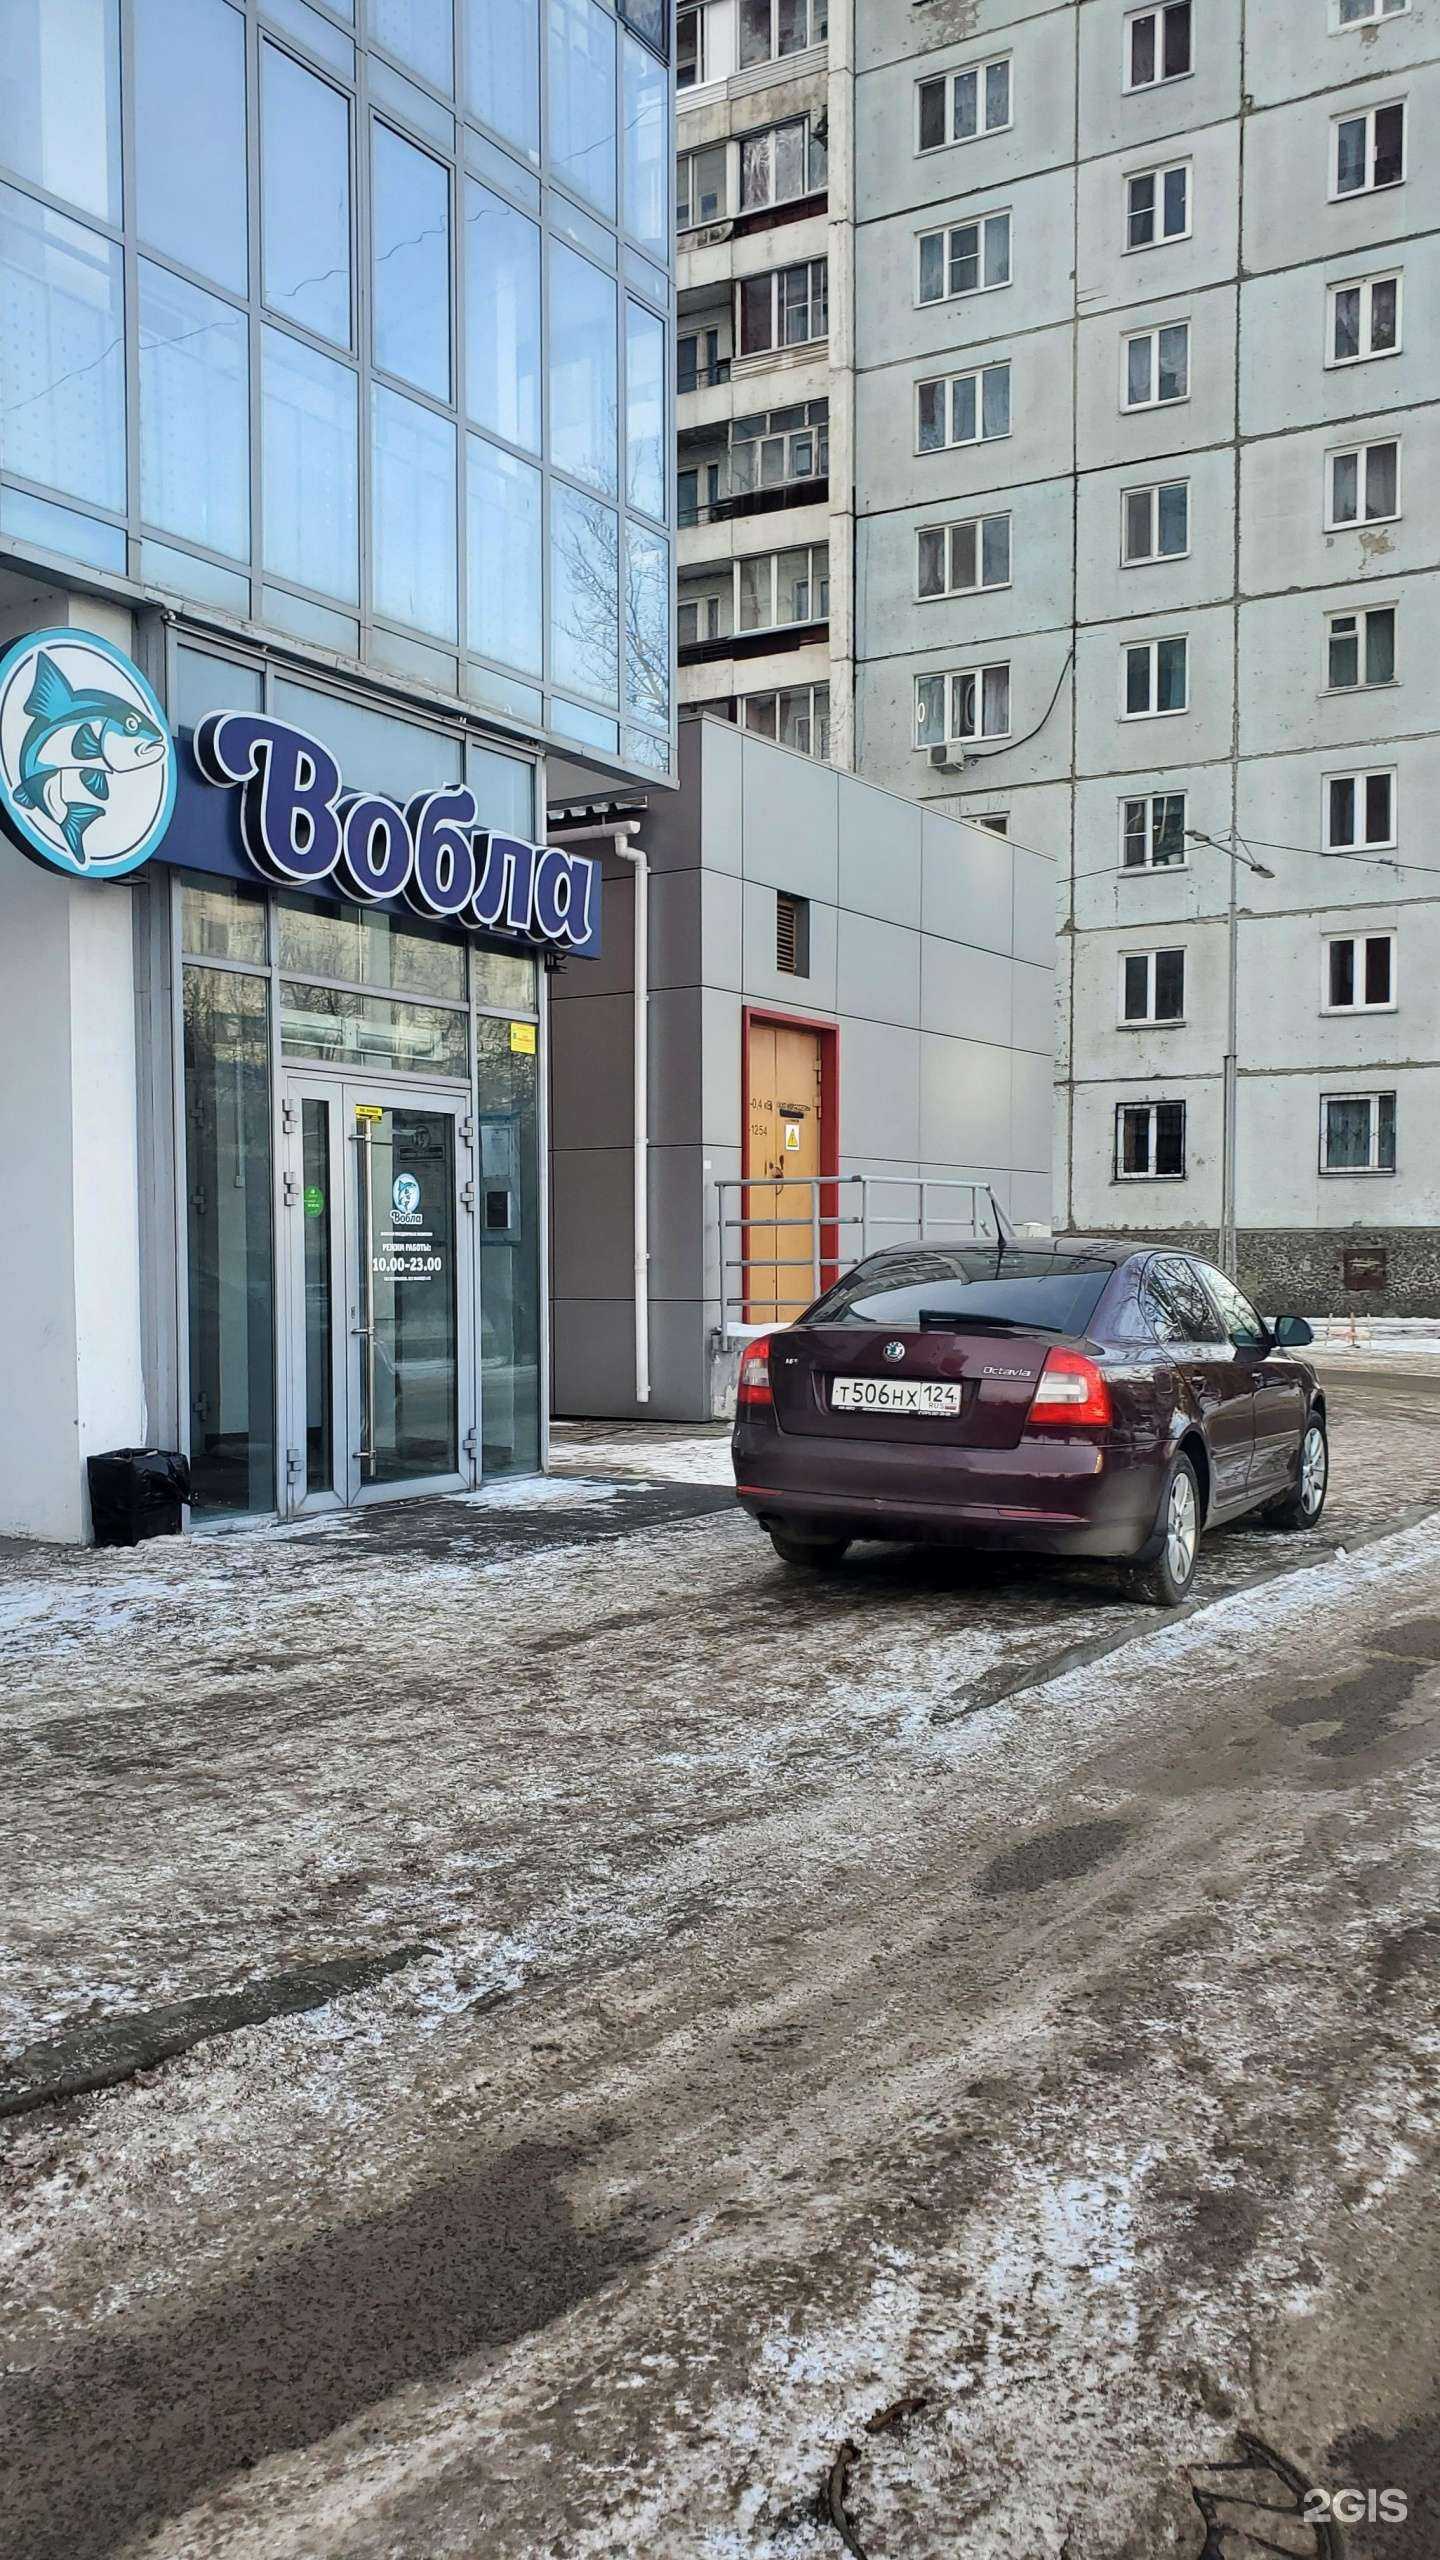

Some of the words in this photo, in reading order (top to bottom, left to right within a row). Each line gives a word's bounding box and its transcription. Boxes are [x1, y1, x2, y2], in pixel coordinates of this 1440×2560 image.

[194, 709, 593, 948] Вобла
[390, 1209, 423, 1225] Вобла
[382, 1243, 405, 1252] РЕЖИМ
[373, 1256, 442, 1272] 10.00-23.00
[983, 1366, 1032, 1377] Octavia
[923, 1385, 955, 1403] 124
